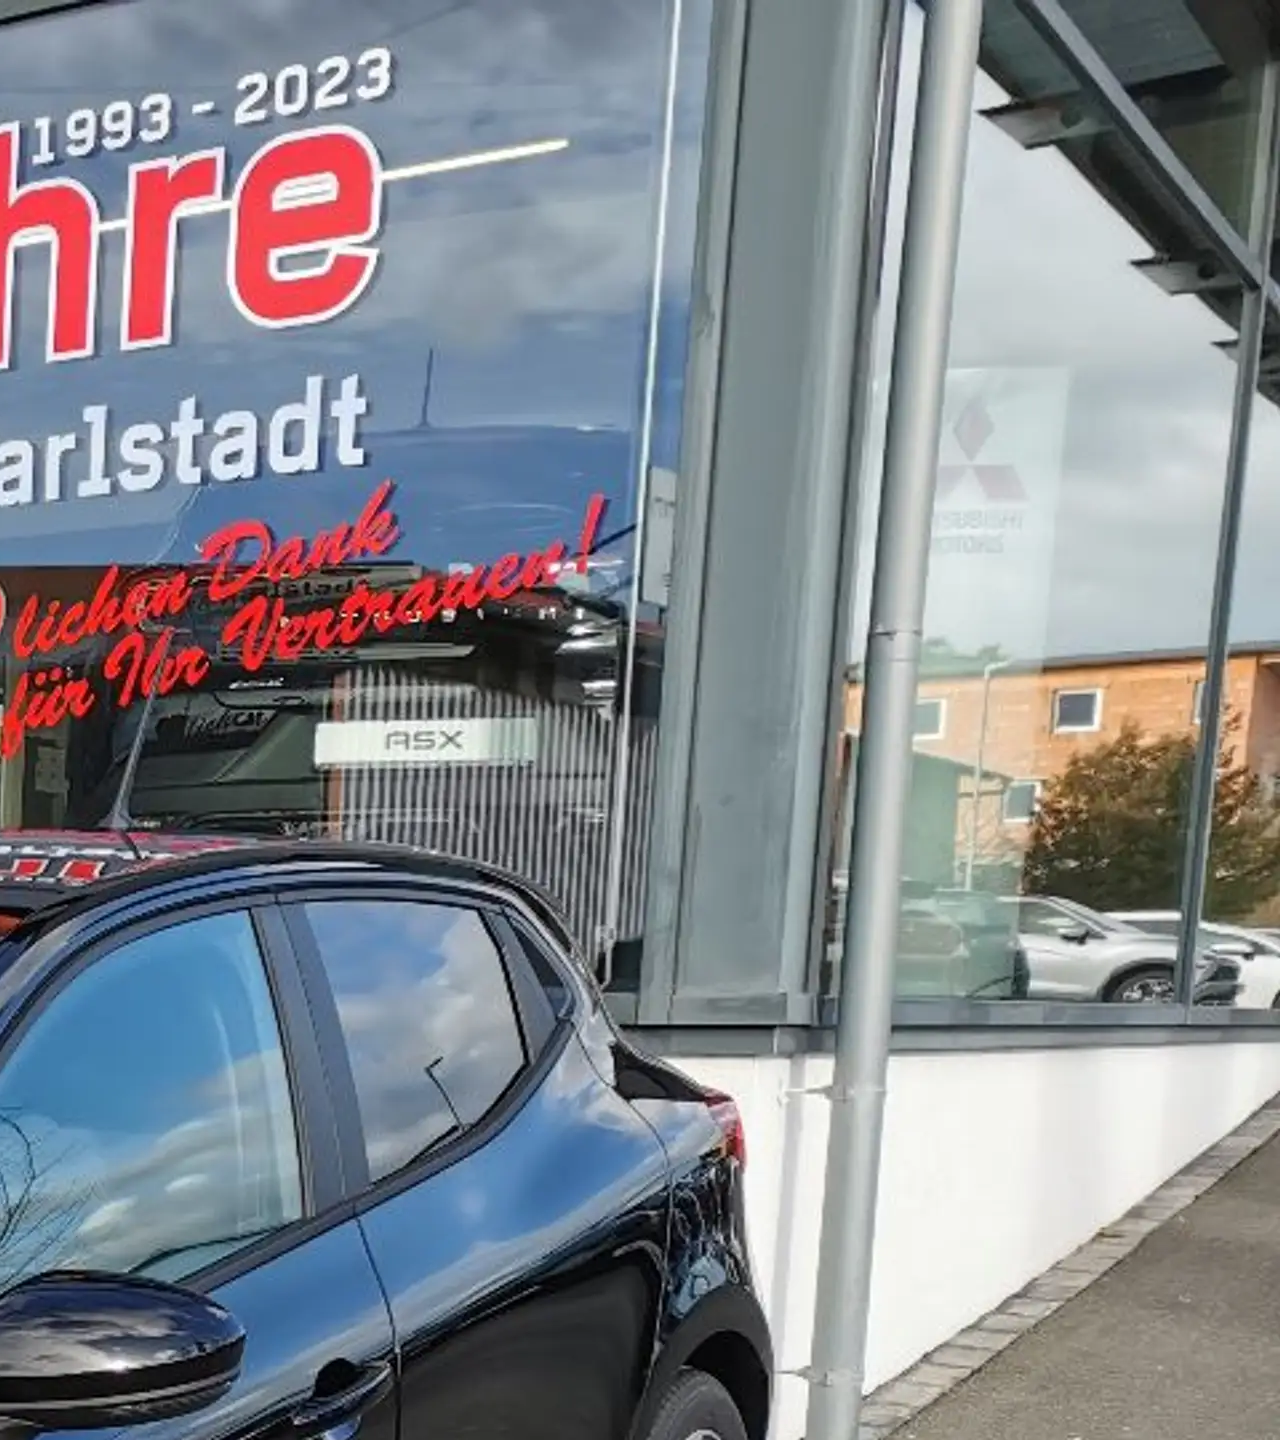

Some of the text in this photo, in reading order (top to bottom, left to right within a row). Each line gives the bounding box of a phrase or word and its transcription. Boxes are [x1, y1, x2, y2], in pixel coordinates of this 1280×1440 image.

[31, 93, 172, 165] 1993
[235, 48, 392, 125] 2023
[0, 493, 605, 761] für Ihr Vertrauen!
[13, 478, 400, 659] lichen Dank
[385, 729, 464, 750] ASX
